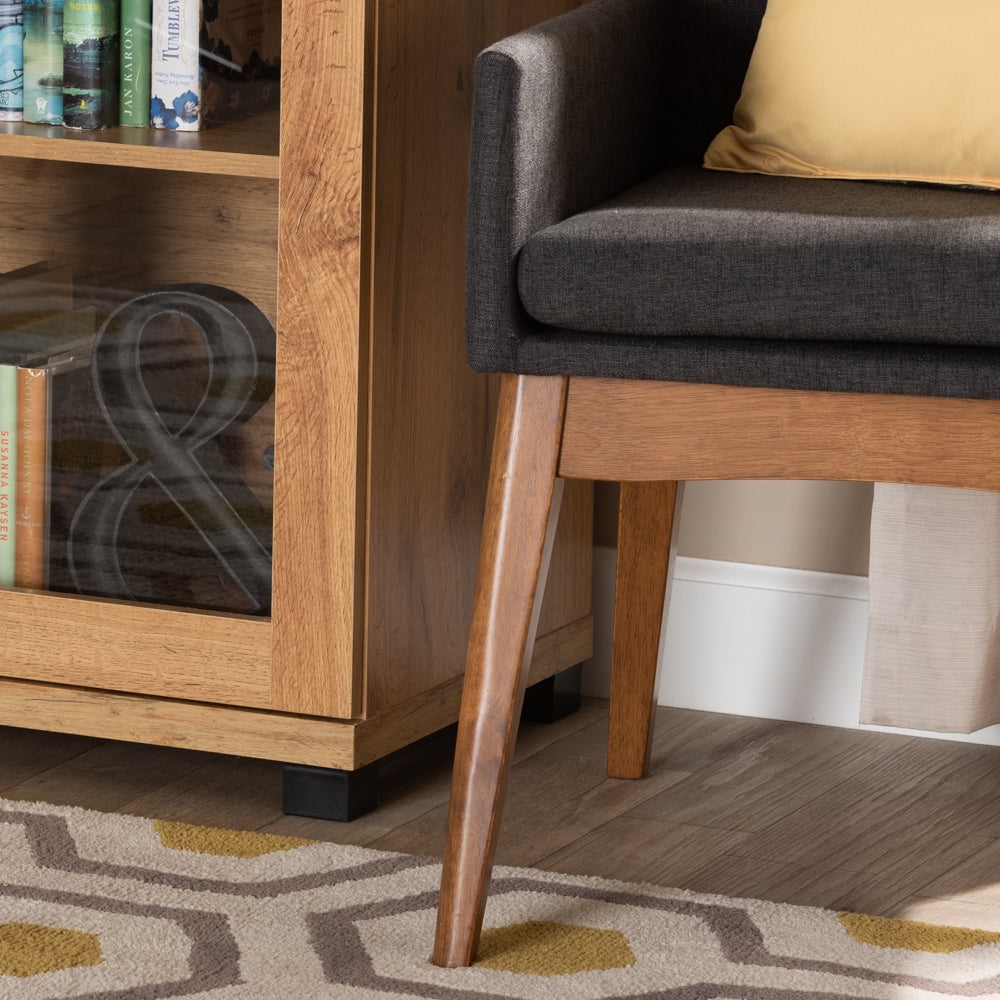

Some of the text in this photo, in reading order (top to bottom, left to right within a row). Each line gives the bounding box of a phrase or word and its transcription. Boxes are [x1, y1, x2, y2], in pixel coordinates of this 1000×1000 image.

[124, 27, 134, 116] JAN KARON
[24, 375, 33, 403] NOT
[23, 418, 33, 440] DAY
[23, 445, 33, 478] GOES
[0, 430, 9, 541] SUSANNA KAYSEN
[23, 482, 32, 495] BY
